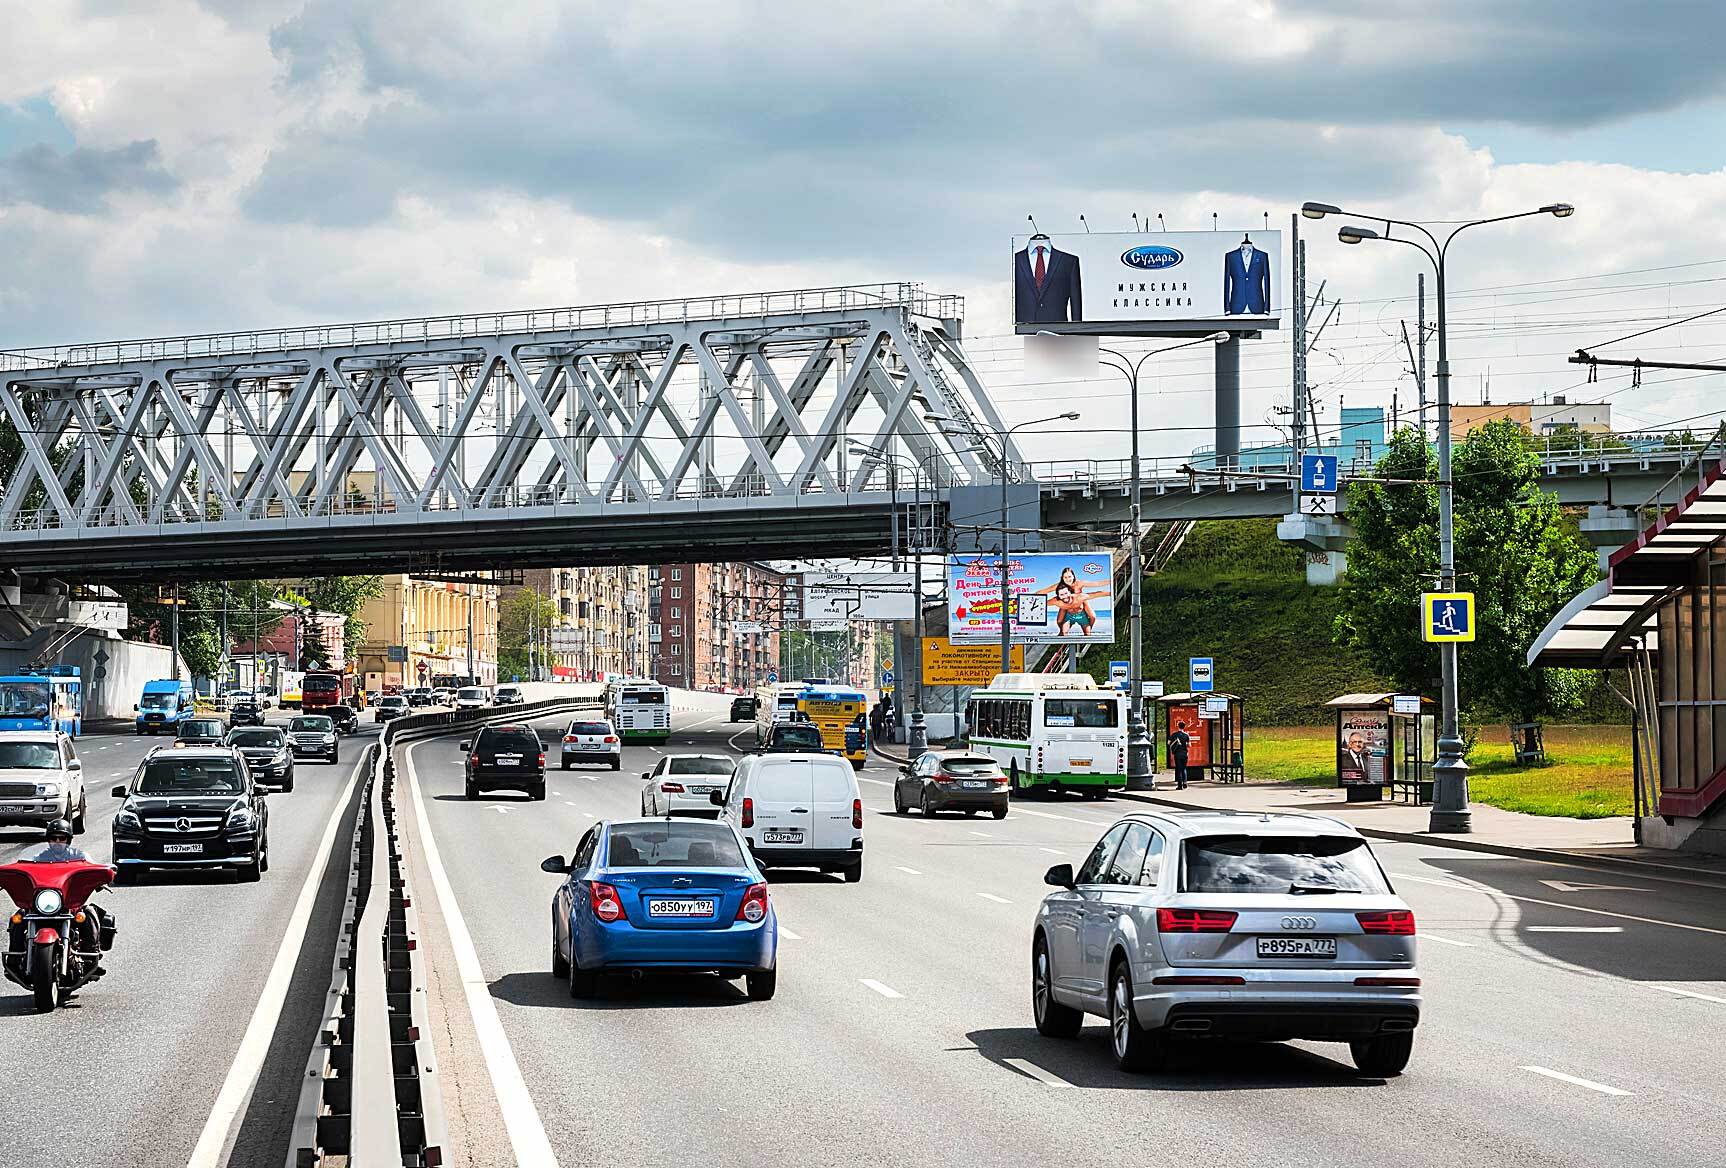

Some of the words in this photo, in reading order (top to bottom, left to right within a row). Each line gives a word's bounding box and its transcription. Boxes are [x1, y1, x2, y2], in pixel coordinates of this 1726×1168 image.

[1131, 251, 1175, 266] Сударь
[1118, 282, 1187, 292] МУЖСКАЯ
[1113, 297, 1192, 308] КЛАССИКА
[956, 579, 982, 590] День
[984, 577, 1036, 588] Родения
[962, 586, 1030, 598] фитнес-уба!
[695, 901, 711, 910] 197
[1313, 940, 1332, 949] 777
